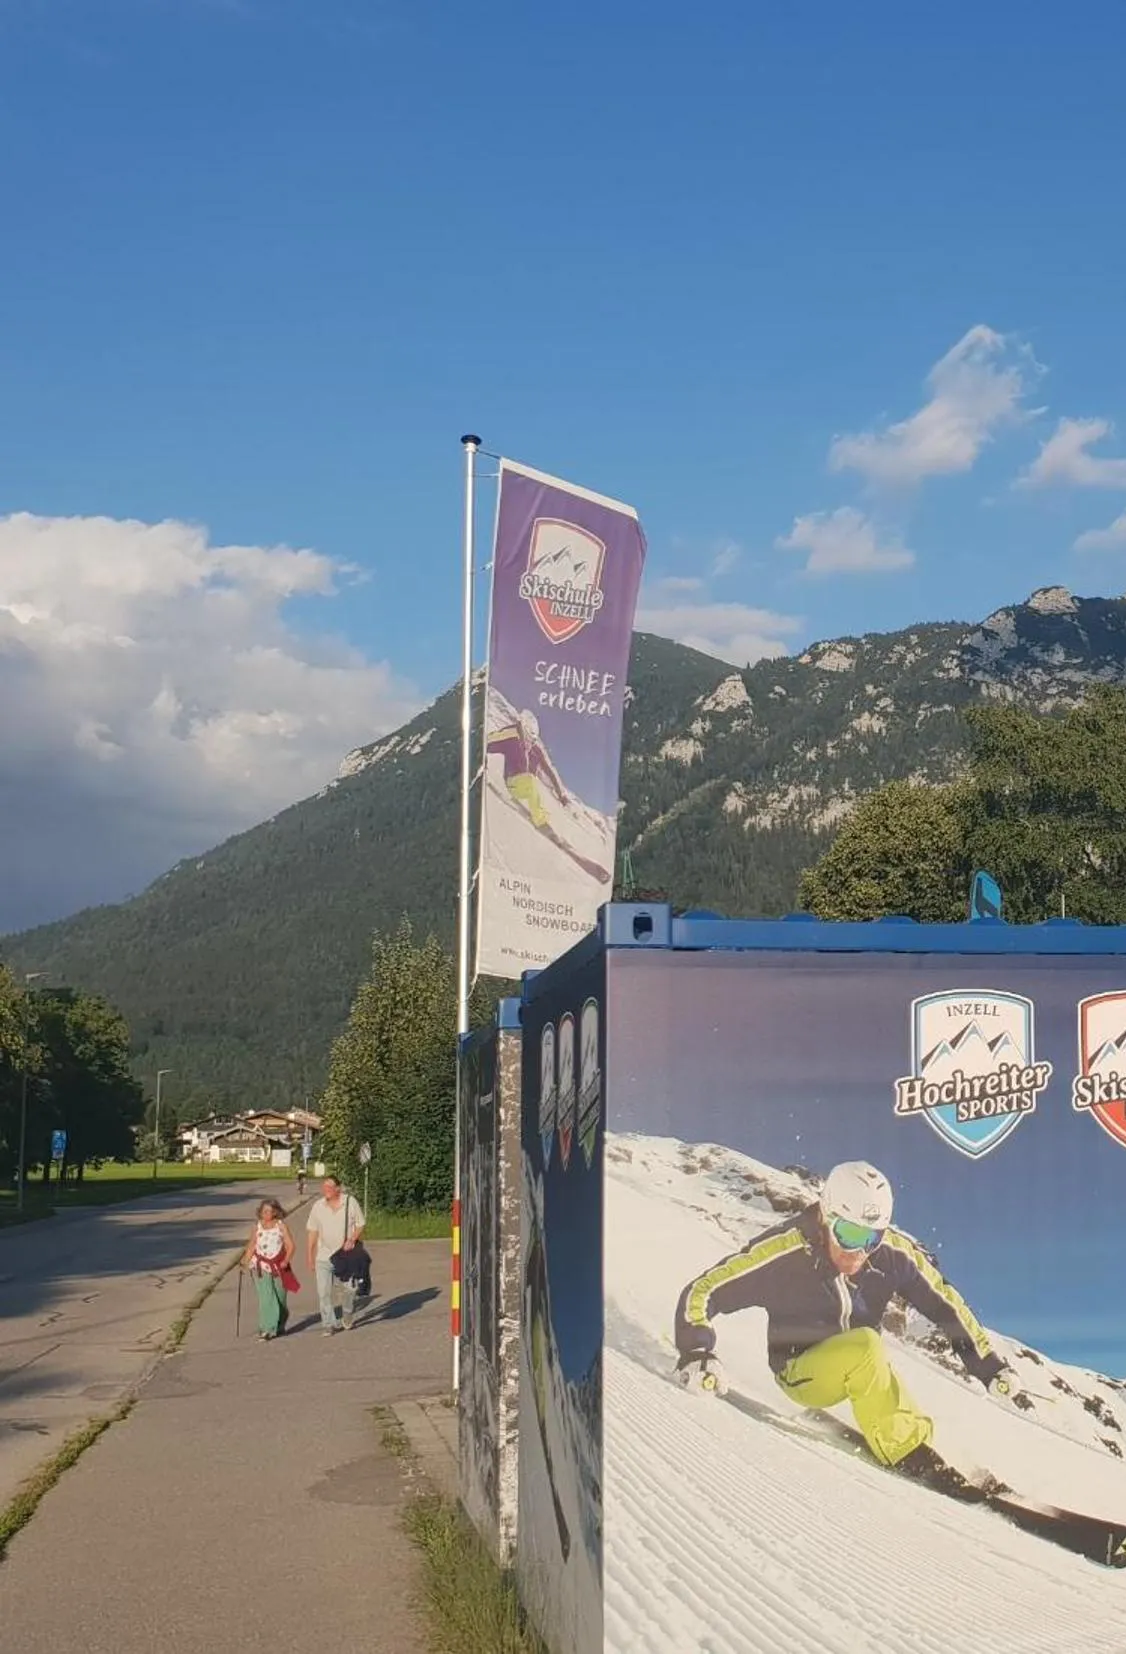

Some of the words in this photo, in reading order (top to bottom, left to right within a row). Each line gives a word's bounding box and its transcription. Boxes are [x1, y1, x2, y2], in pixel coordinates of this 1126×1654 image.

[521, 575, 601, 606] Skischule
[550, 601, 593, 620] INZELL
[534, 660, 616, 695] SCHNEE
[539, 689, 612, 717] erleben
[499, 878, 531, 896] ALPIN
[512, 895, 574, 917] NORDISCH
[946, 1003, 1000, 1017] INZELL
[899, 1064, 1048, 1110] Hochreiter
[958, 1090, 1032, 1121] SPORTS
